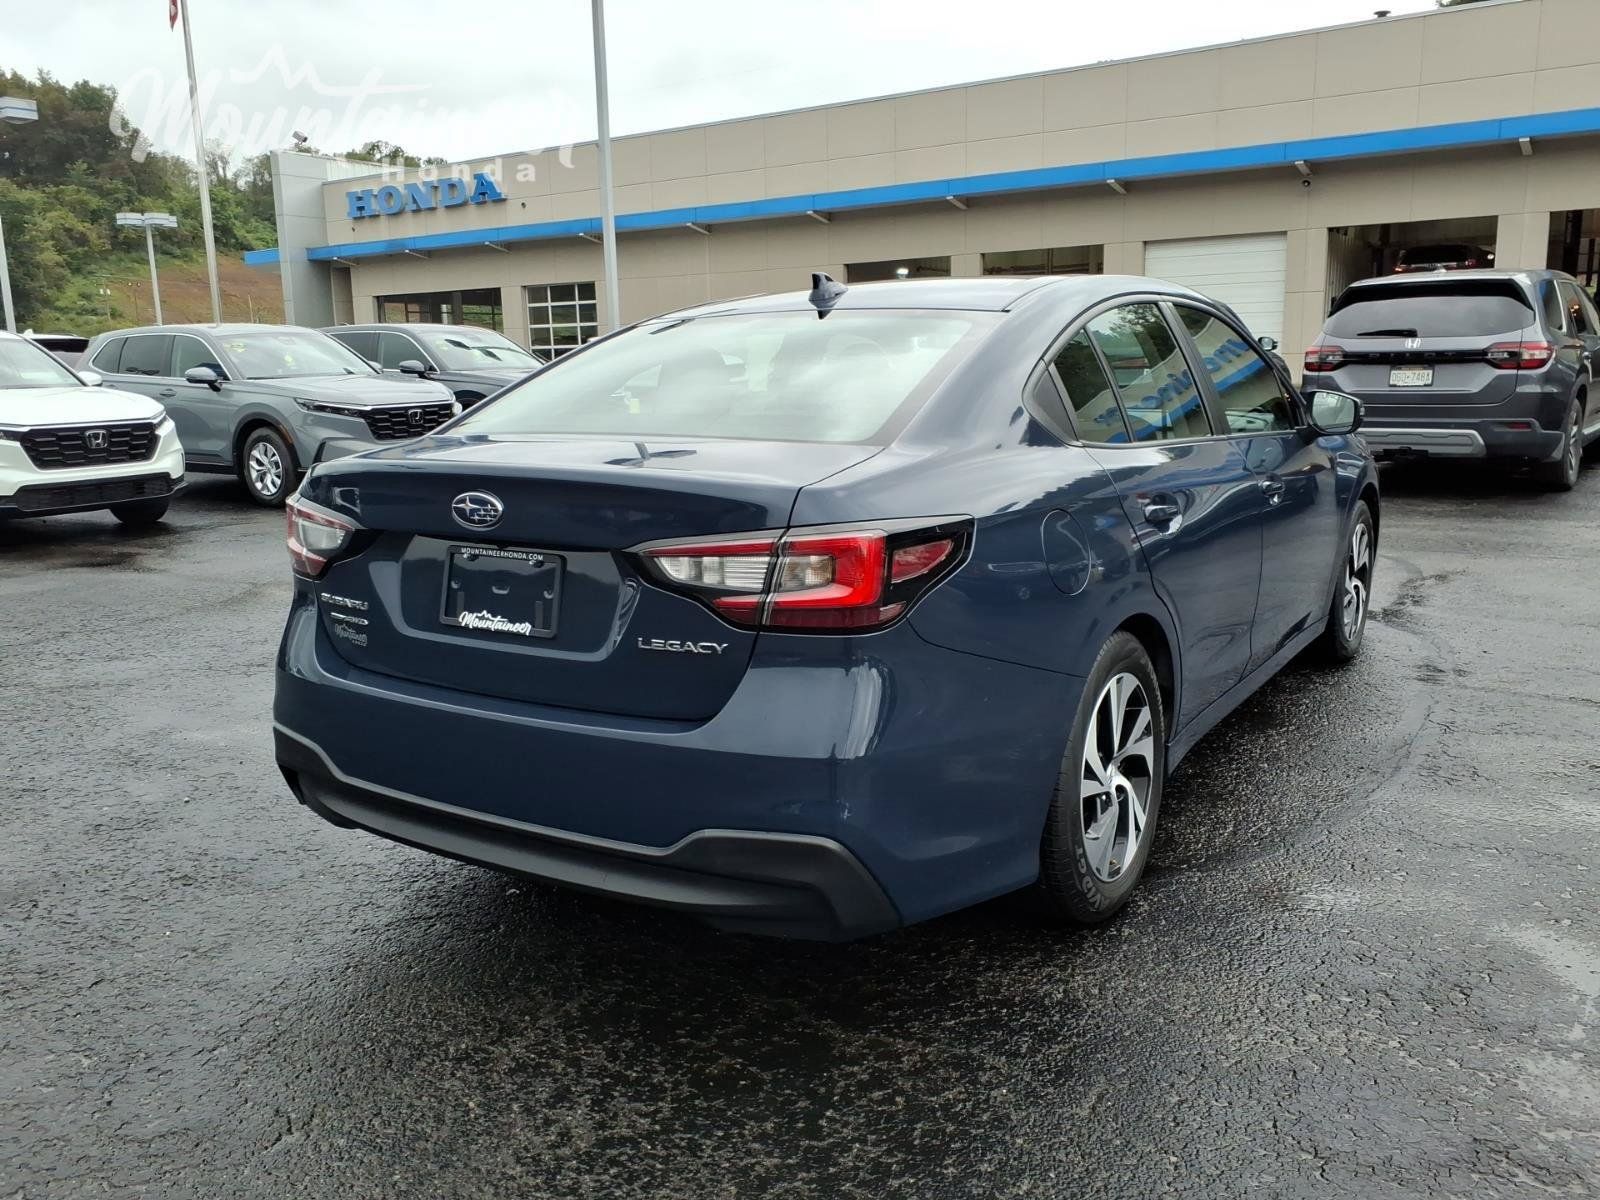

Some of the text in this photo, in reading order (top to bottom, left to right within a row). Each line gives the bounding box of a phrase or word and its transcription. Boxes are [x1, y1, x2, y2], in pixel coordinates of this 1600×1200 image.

[346, 172, 507, 218] HONDA
[461, 547, 544, 561] MOUNTAINEERHONDA.COM
[321, 592, 369, 610] SUBARU
[458, 609, 532, 636] Mountaineer
[637, 637, 729, 655] LEGACY
